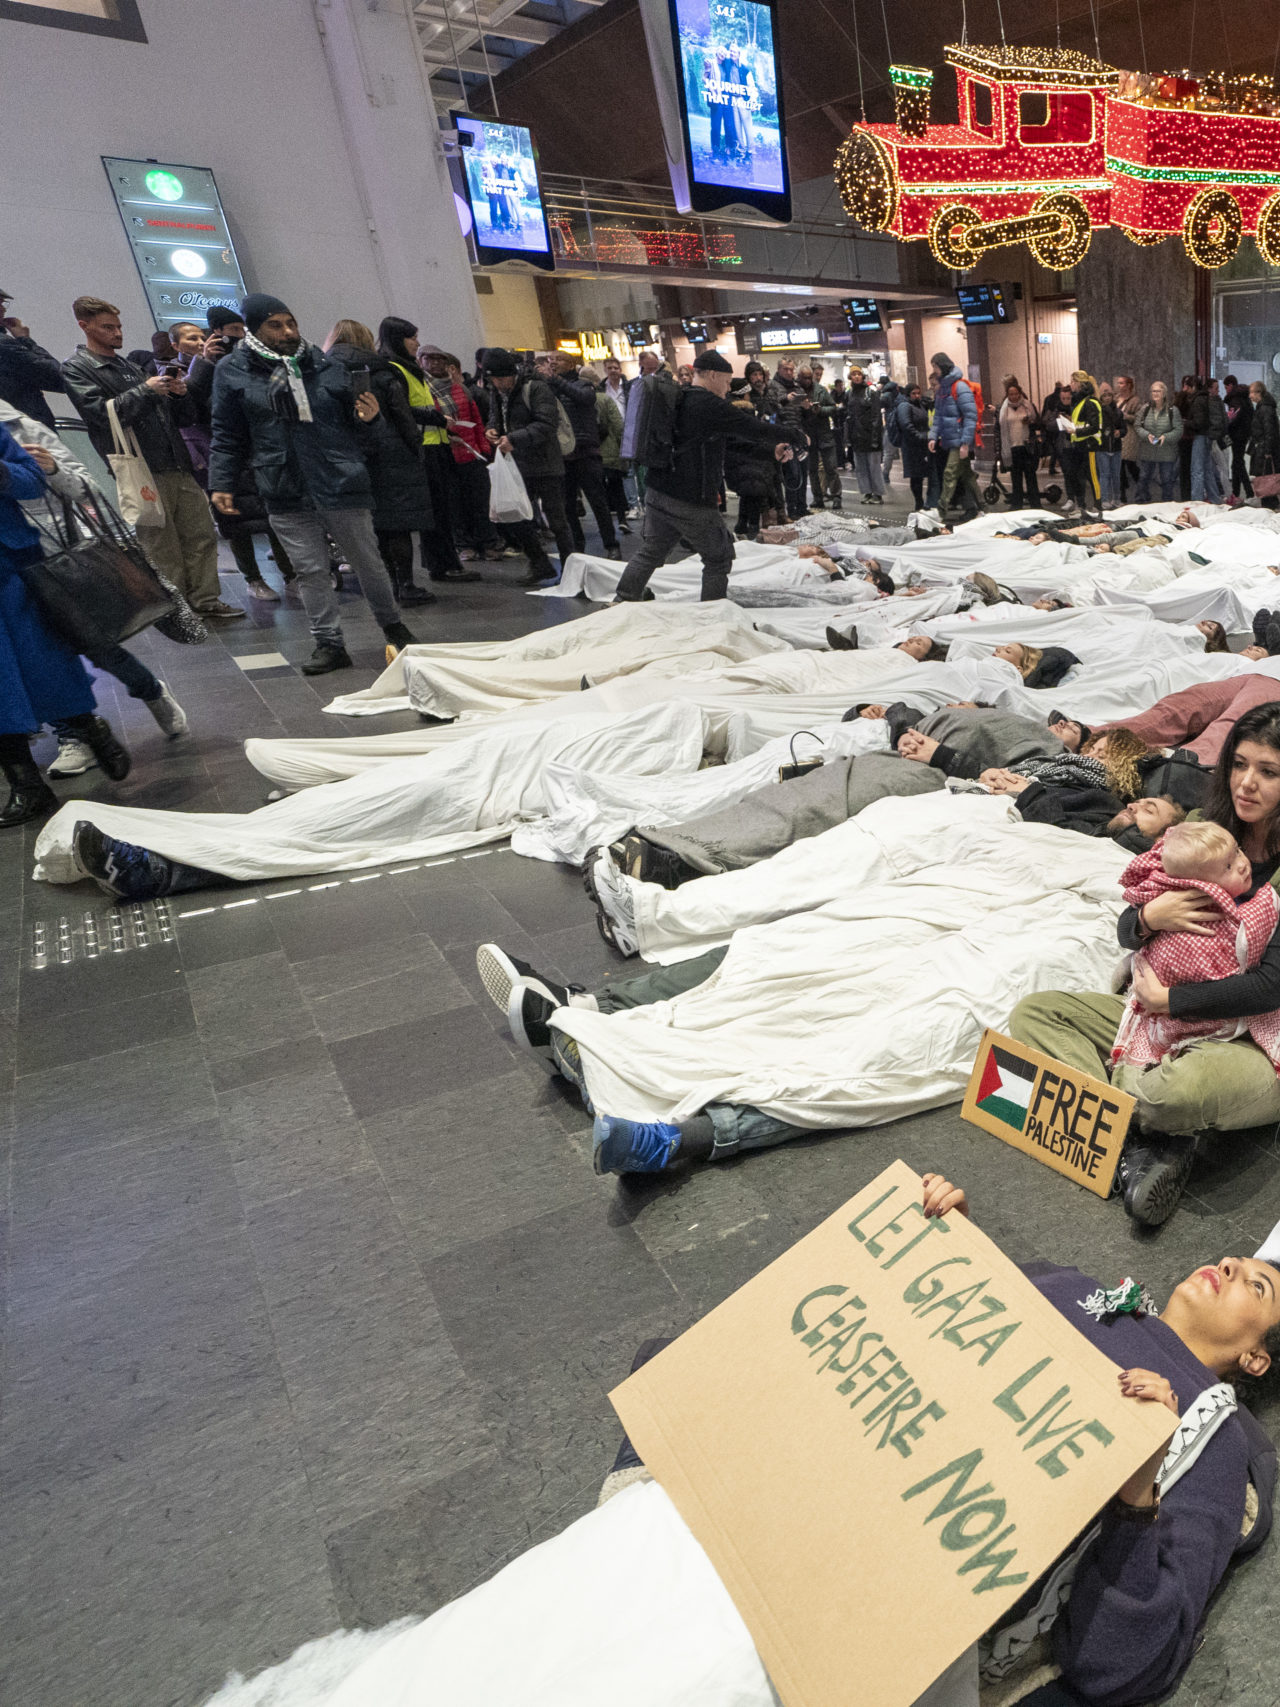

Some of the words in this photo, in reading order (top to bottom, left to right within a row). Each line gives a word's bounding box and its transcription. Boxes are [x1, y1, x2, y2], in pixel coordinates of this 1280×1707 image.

[714, 5, 736, 18] SAS
[701, 91, 729, 106] THAT
[704, 79, 759, 100] JOURNEYS
[1031, 1069, 1120, 1157] FREE
[1025, 1116, 1102, 1179] PALESTINE
[847, 1185, 950, 1270] LET
[902, 1256, 1023, 1367] GAZA
[992, 1356, 1116, 1480] LIVE
[790, 1284, 948, 1459] CEASEFIRE
[900, 1447, 1030, 1595] NOW
